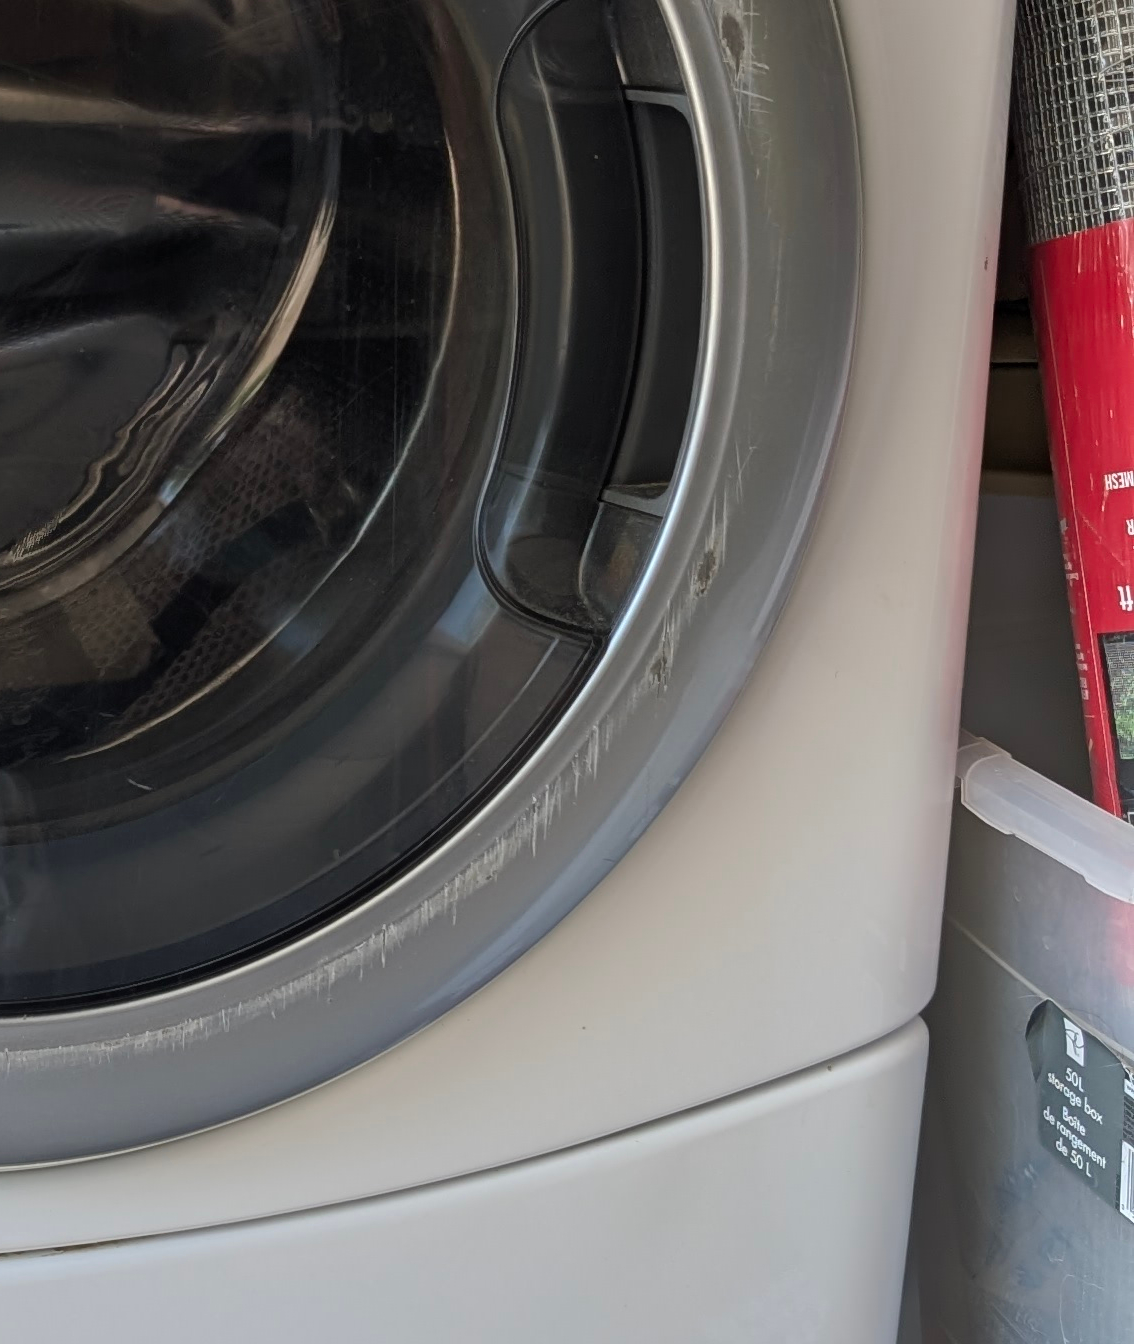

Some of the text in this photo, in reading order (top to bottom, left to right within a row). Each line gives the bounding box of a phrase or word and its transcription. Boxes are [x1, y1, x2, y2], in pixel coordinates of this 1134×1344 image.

[1048, 1072, 1082, 1107] storage
[1084, 1097, 1103, 1125] box
[1066, 1068, 1084, 1092] 50L
[1043, 1106, 1055, 1126] de
[1056, 1121, 1106, 1169] rangement
[1063, 1106, 1086, 1136] Boîte
[1056, 1138, 1092, 1178] de 50 L
